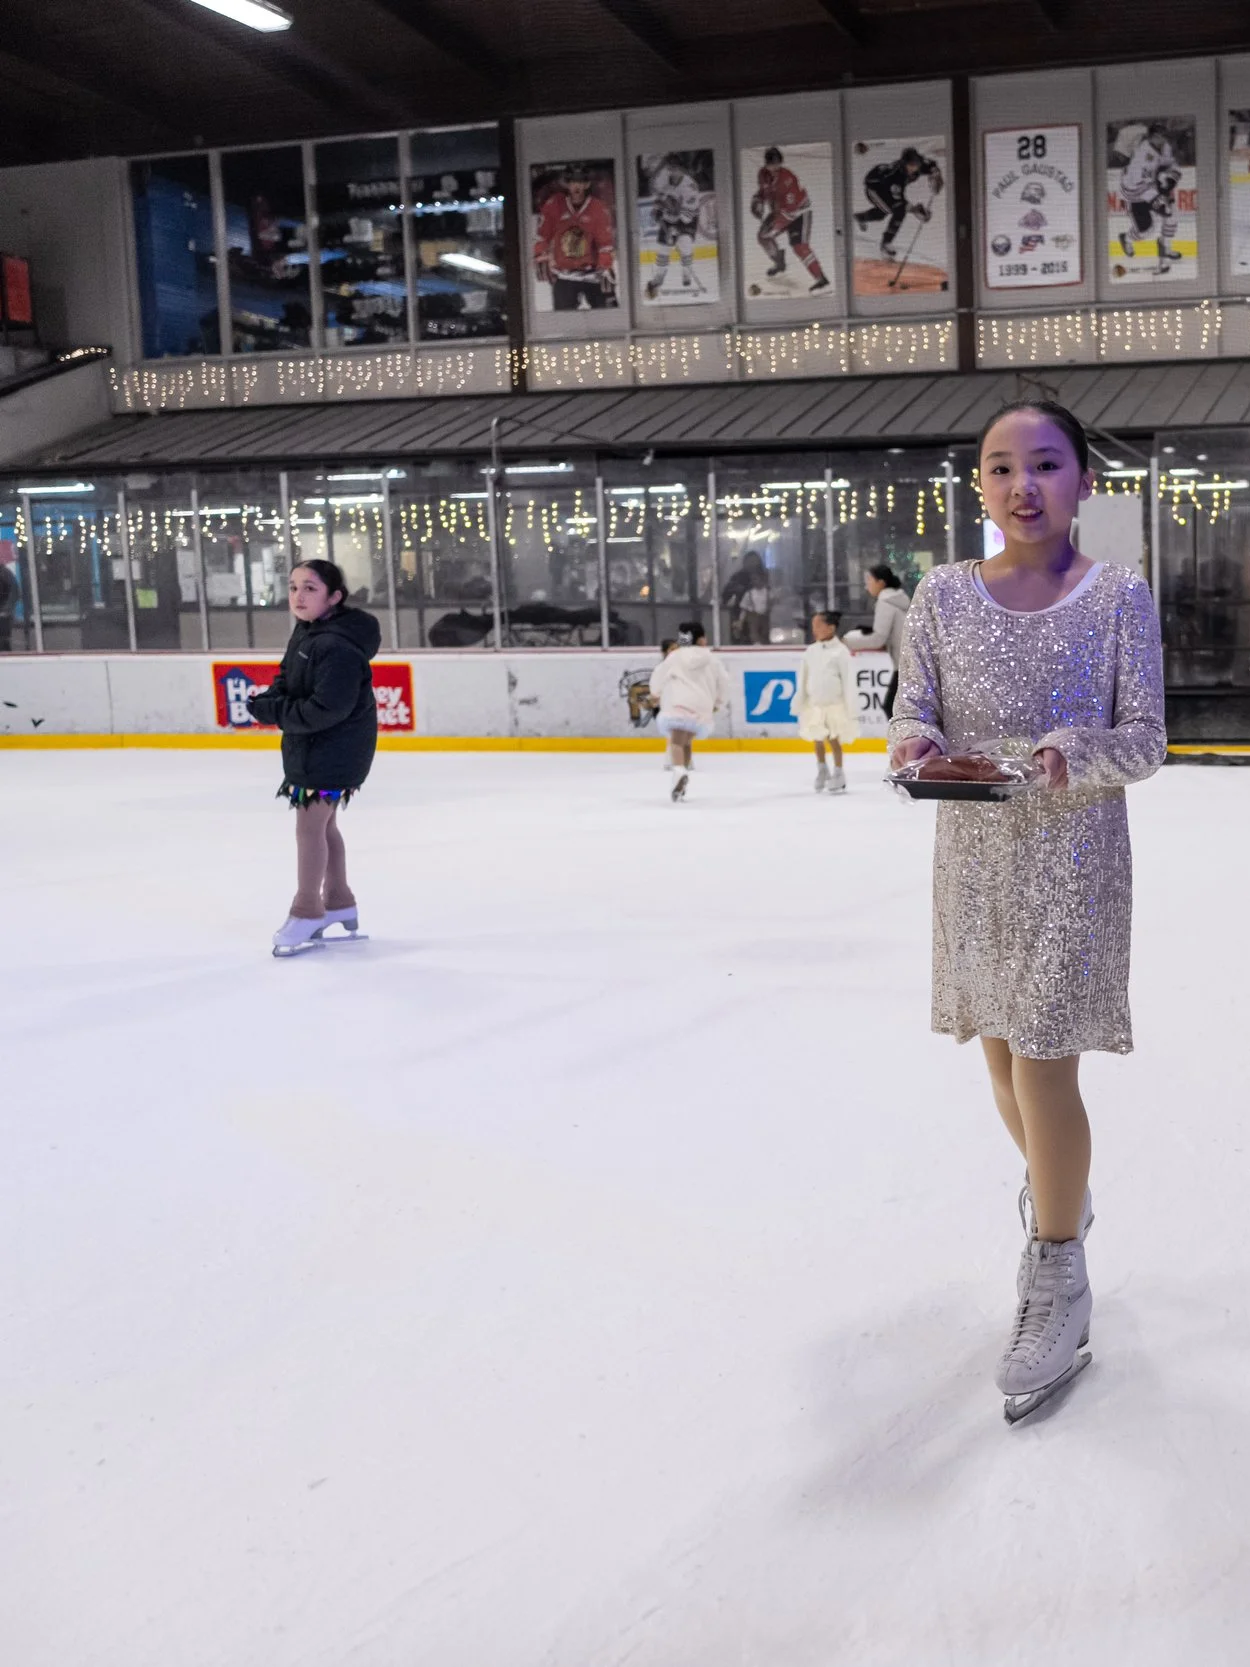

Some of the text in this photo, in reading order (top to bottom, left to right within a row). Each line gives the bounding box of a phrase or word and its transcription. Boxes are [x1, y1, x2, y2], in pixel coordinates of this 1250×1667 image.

[1017, 135, 1047, 160] 28
[992, 163, 1074, 199] PAUL GAUSTAD
